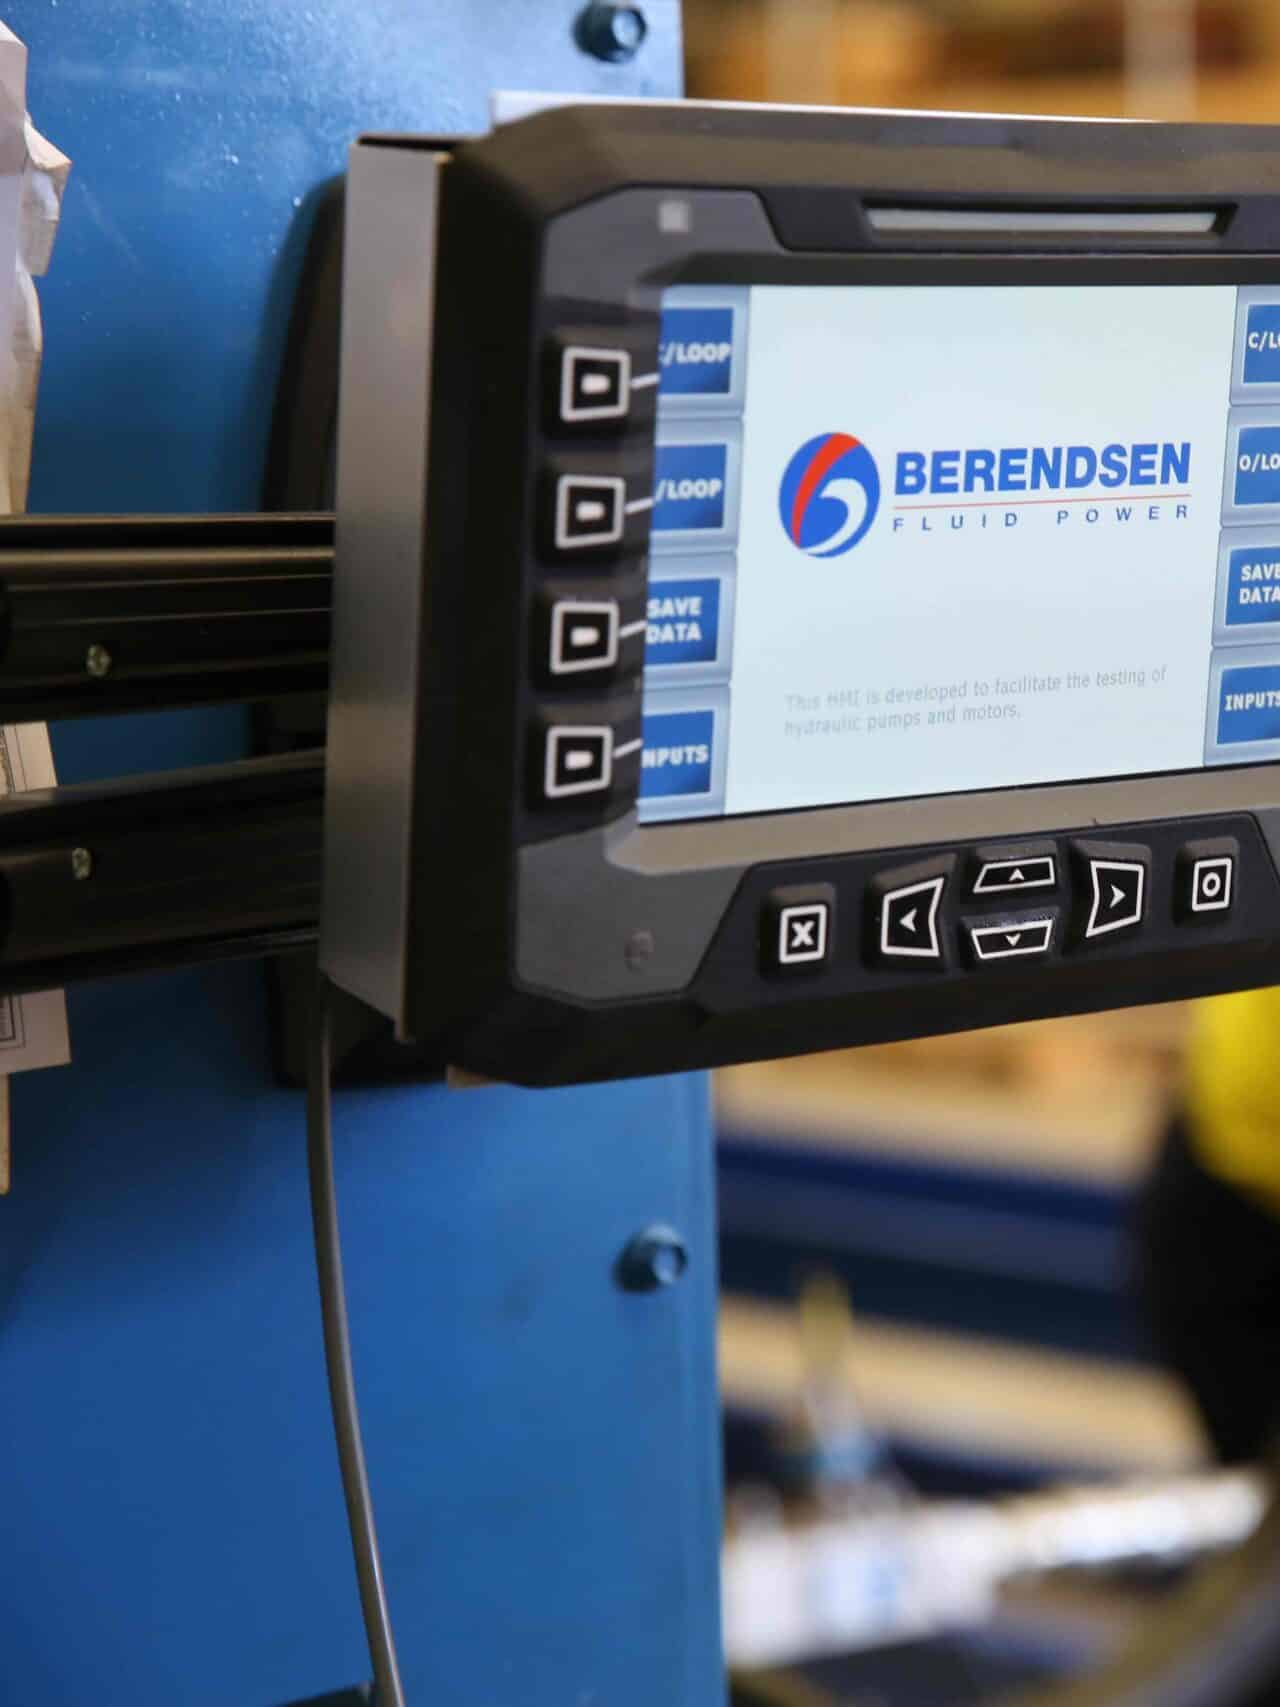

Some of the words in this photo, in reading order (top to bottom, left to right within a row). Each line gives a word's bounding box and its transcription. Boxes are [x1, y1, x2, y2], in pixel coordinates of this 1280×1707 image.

[894, 442, 1192, 495] BERENDSEN
[654, 478, 722, 502] /LOOP
[892, 511, 1018, 532] FLUID
[1057, 504, 1188, 526] POWER
[645, 596, 703, 619] SAVE
[644, 622, 702, 645] DATA
[866, 689, 882, 705] is
[885, 681, 968, 705] developed
[974, 681, 989, 697] to
[995, 675, 1062, 696] facilitate
[1067, 672, 1091, 689] the
[1096, 666, 1146, 688] testing
[1152, 664, 1168, 683] of
[785, 717, 860, 740] hydraulic
[867, 712, 922, 735] pumps
[927, 706, 956, 725] and
[963, 704, 1022, 721] motors.
[641, 744, 709, 769] NPUTS
